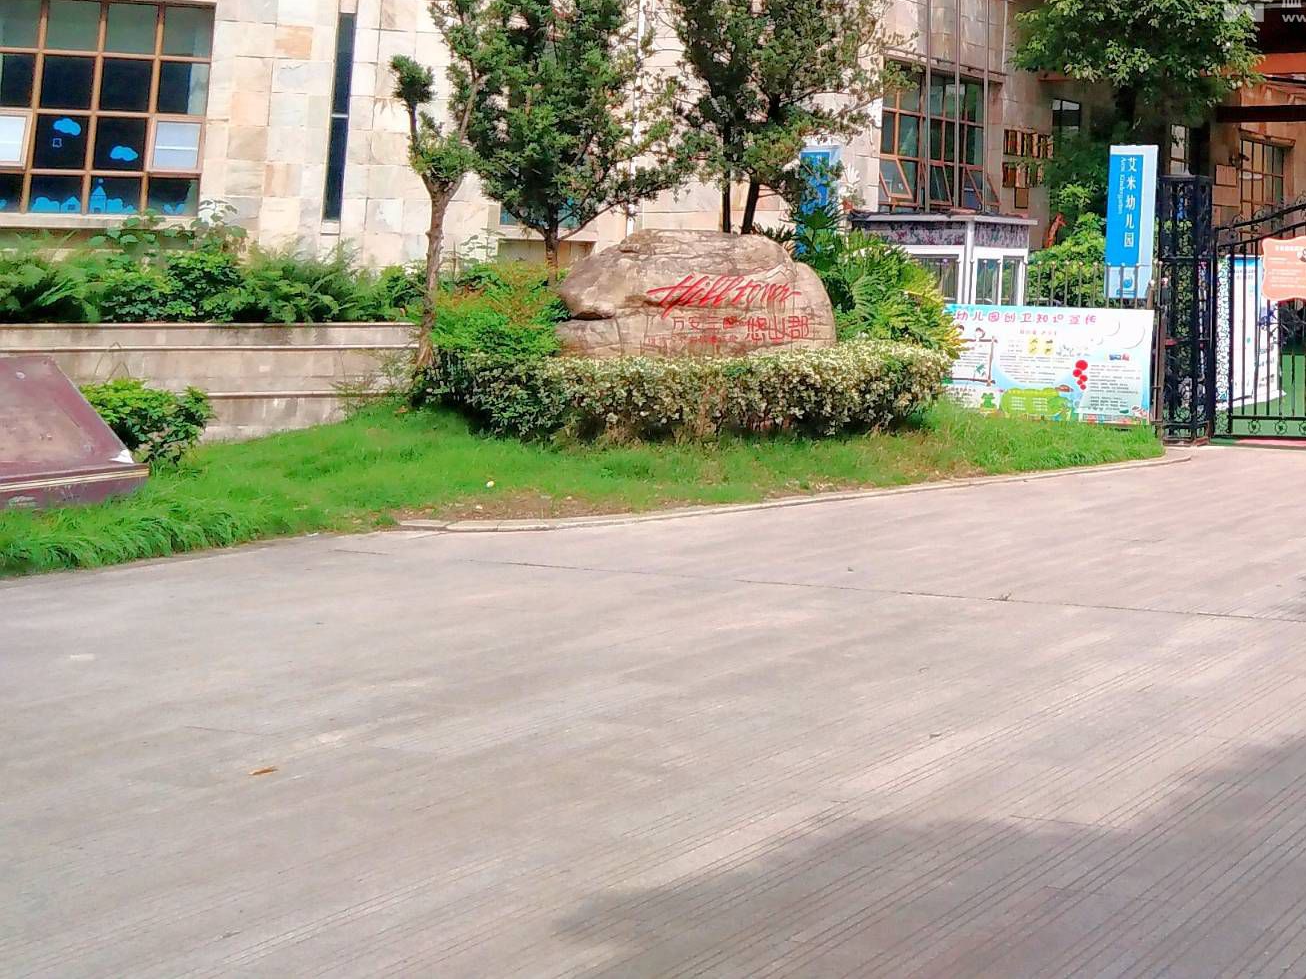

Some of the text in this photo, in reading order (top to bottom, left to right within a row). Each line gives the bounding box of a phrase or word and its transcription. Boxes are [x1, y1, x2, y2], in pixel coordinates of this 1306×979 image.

[1123, 157, 1138, 248] 艾米幼儿园
